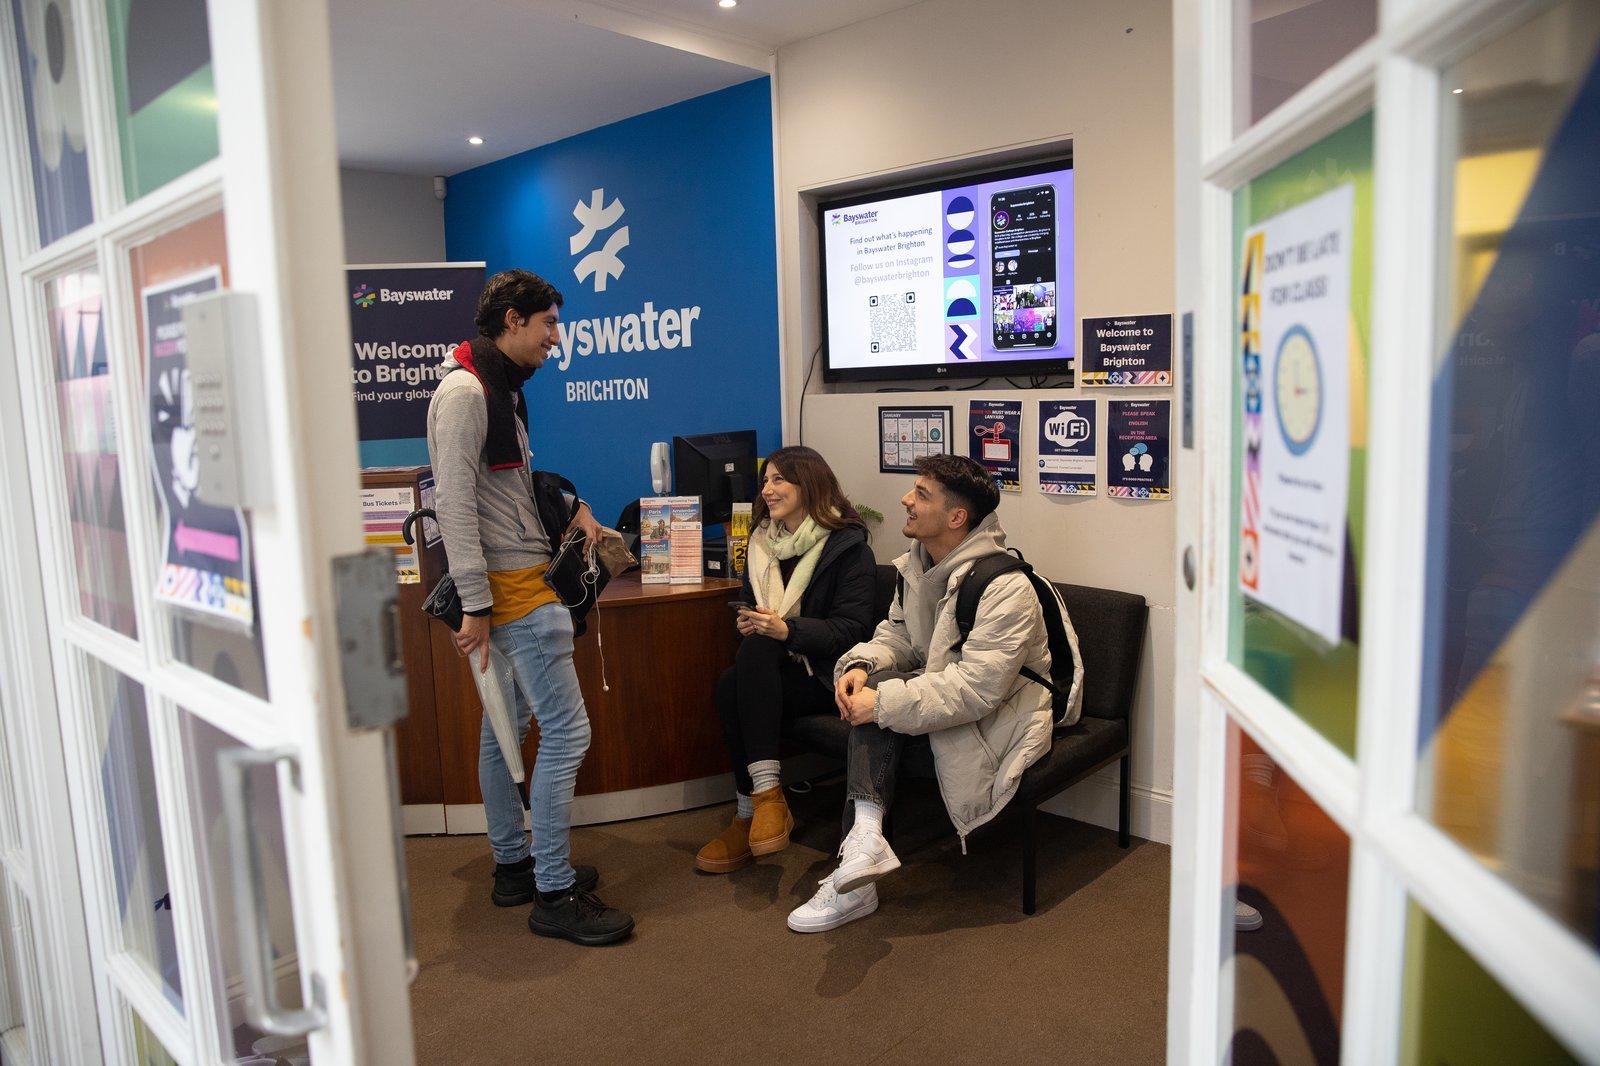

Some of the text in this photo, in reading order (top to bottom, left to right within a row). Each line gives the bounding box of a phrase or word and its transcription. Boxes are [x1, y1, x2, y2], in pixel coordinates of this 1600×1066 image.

[844, 210, 878, 223] Bayswater
[850, 237, 863, 245] Find
[876, 232, 897, 241] what's
[898, 227, 933, 239] happening
[864, 245, 896, 255] Bayswater
[898, 240, 925, 250] Brighton
[851, 263, 873, 272] Follow
[896, 256, 934, 267] Instagram
[854, 270, 930, 285] @bayswaterbrighton
[380, 288, 454, 305] Bayswater
[547, 302, 701, 371] yswater
[1096, 328, 1153, 338] Welcome to
[1100, 343, 1152, 354] Bayswater
[1103, 357, 1145, 368] Brighton
[376, 362, 444, 386] Bright
[376, 392, 403, 402] your
[405, 389, 436, 401] globa
[566, 377, 649, 402] BRIGHTON
